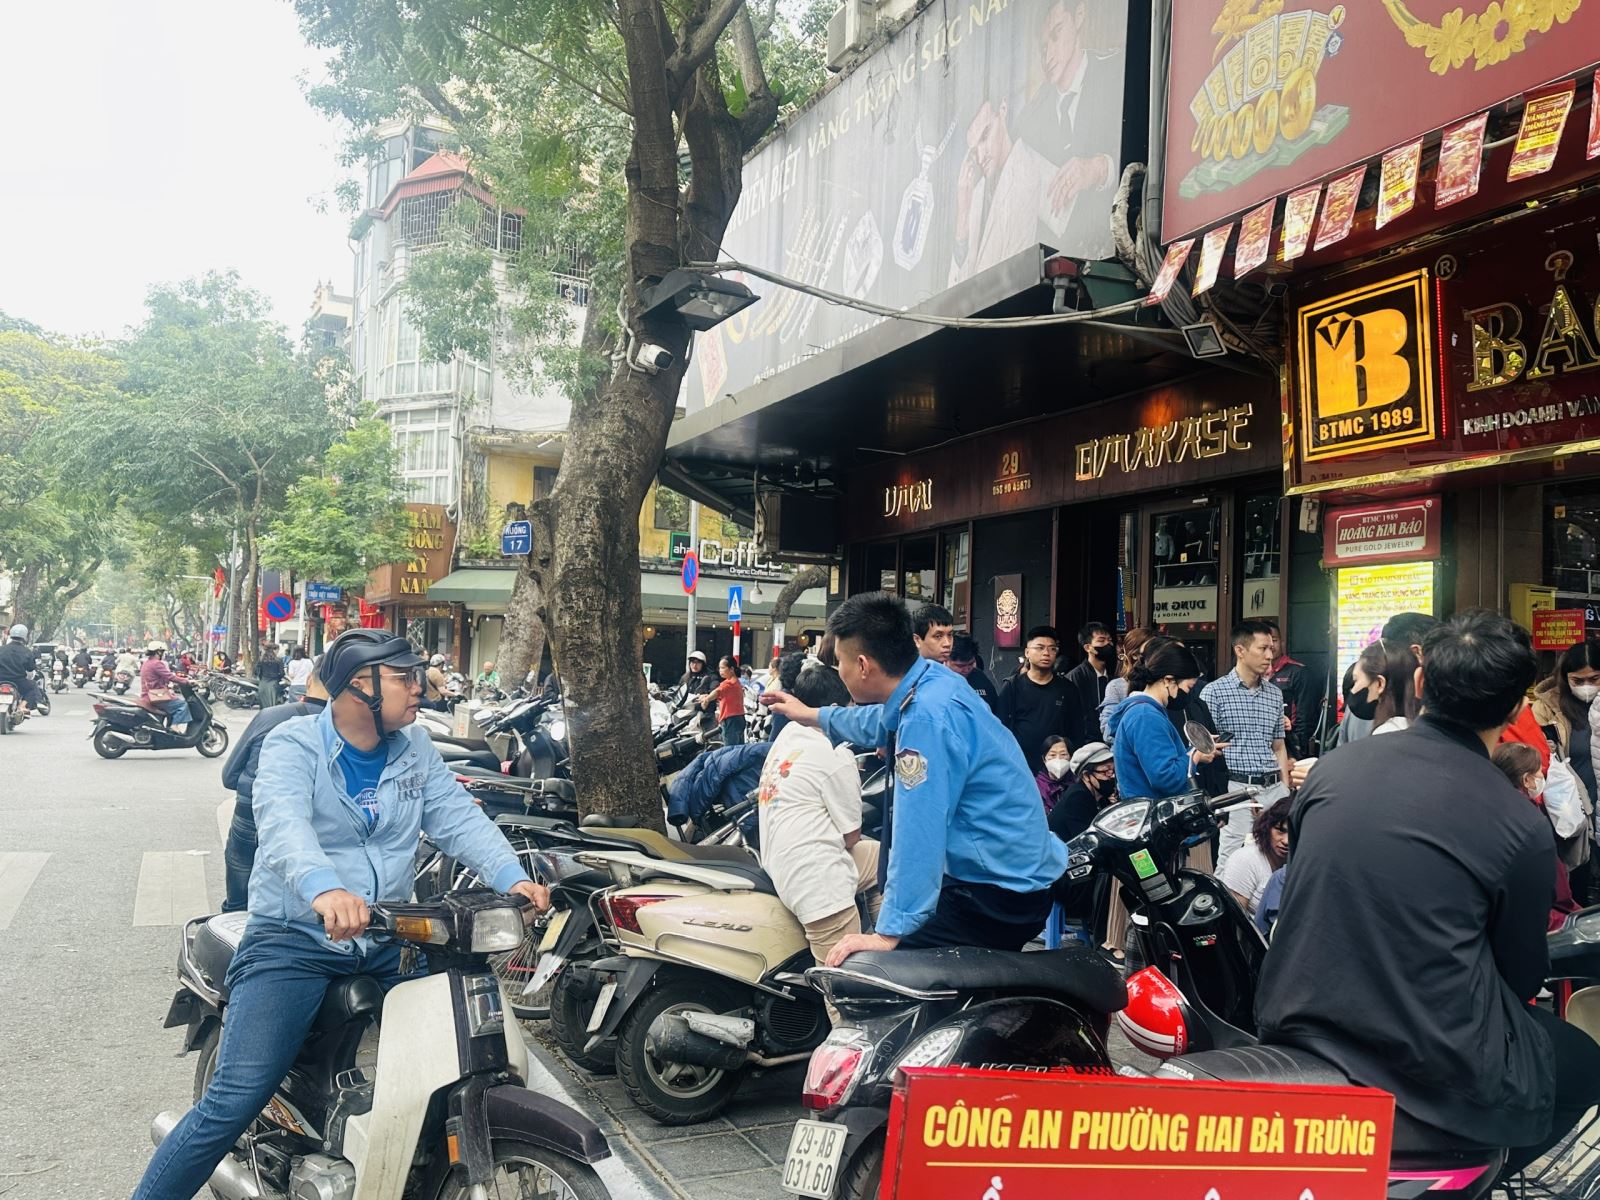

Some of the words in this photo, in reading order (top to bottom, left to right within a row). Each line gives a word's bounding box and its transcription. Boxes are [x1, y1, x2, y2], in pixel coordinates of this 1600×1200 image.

[807, 107, 850, 159] VÀNG
[855, 53, 916, 124] TRANG
[921, 14, 962, 72] SỨC
[968, 0, 1011, 35] NA
[1463, 250, 1600, 392] BẢ
[1319, 417, 1364, 441] BTMC
[1370, 406, 1414, 431] 1989
[1463, 413, 1500, 435] KINH
[1502, 403, 1564, 429] DOANH
[1002, 451, 1019, 476] 29
[1339, 523, 1376, 541] HOÀNG
[1376, 522, 1397, 537] KIM
[1398, 516, 1423, 535] BẢO
[1362, 515, 1381, 524] BTMC
[1382, 513, 1399, 522] 1989
[510, 540, 523, 550] 17
[1345, 545, 1361, 553] PURE
[1384, 540, 1415, 550] JEWELRY
[683, 918, 753, 932] LEAD
[796, 1126, 837, 1159] 29-AB
[923, 1099, 1013, 1148] CÔNG
[1018, 1109, 1063, 1149] AN
[1069, 1106, 1189, 1152] PHƯỜNG
[1196, 1115, 1244, 1153] HAI
[1249, 1111, 1285, 1153] BÀ
[1293, 1114, 1377, 1156] TRƯNG
[785, 1158, 833, 1193] 031.60
